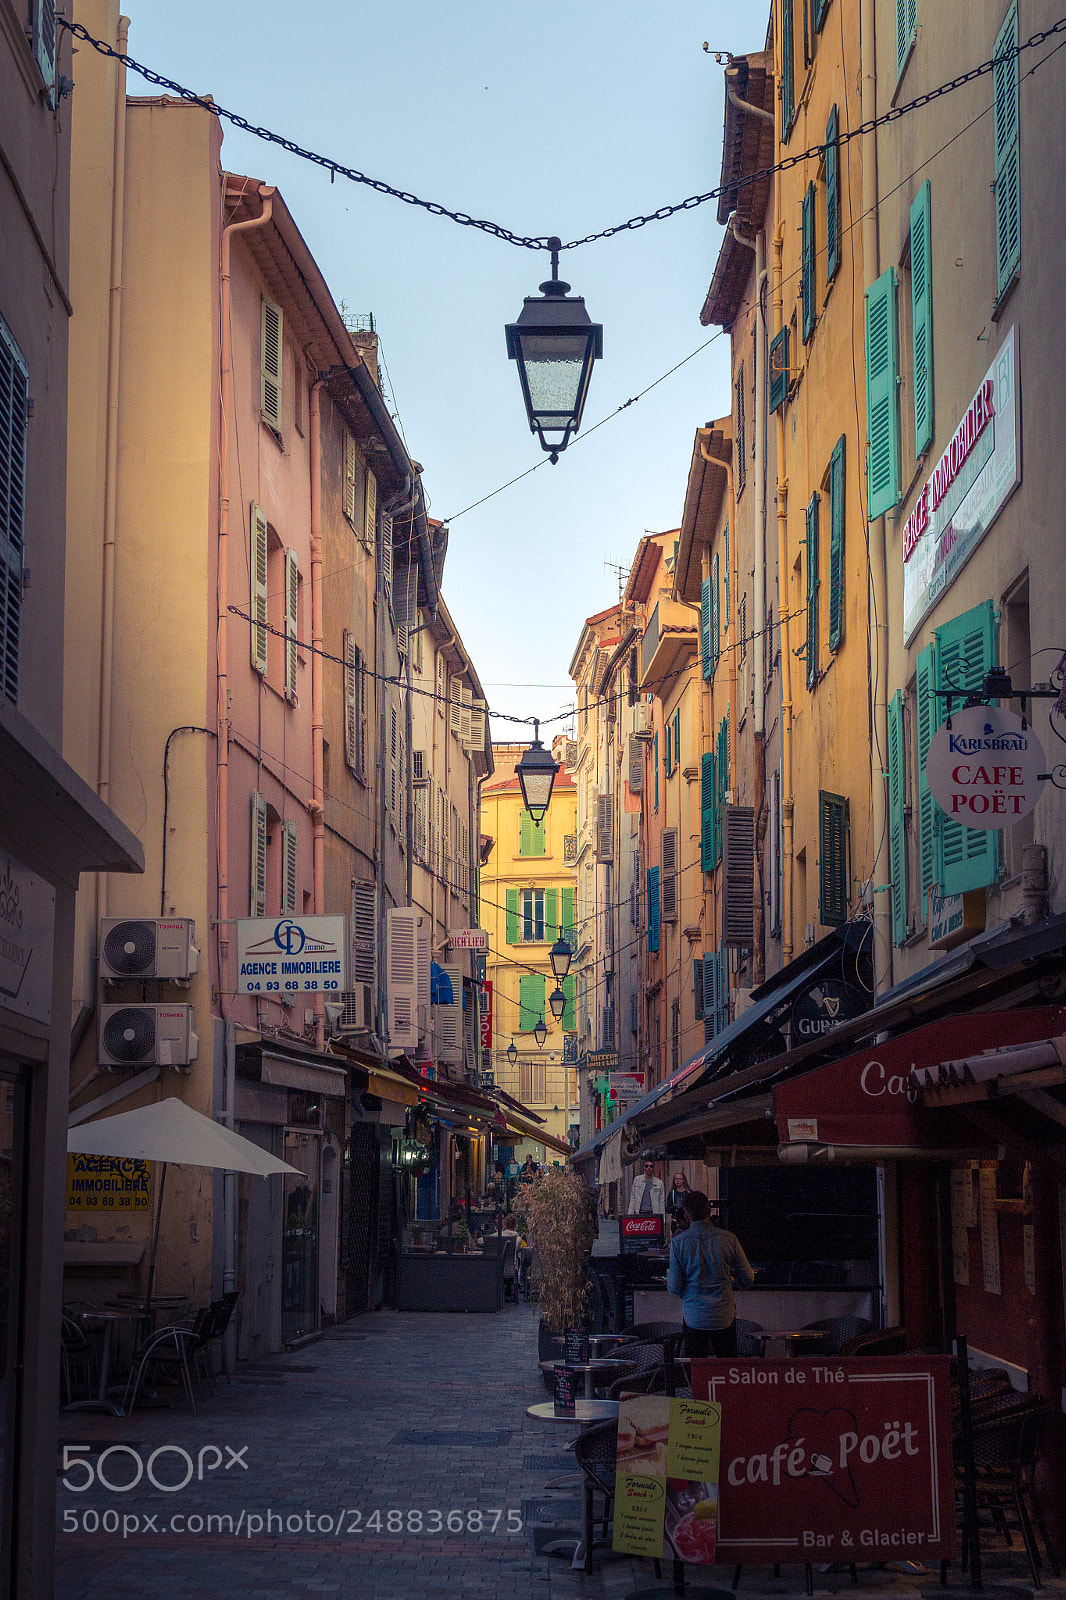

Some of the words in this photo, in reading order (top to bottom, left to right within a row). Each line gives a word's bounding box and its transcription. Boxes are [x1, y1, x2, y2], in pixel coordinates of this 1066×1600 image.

[932, 380, 995, 512] IMMOBILIER
[952, 766, 1024, 785] CAFE
[950, 790, 1026, 814] POËT
[305, 943, 325, 951] immo
[240, 962, 277, 975] AGENCE
[282, 961, 341, 975] IMMOBILIERE
[247, 982, 261, 991] 04
[266, 982, 279, 990] 93
[285, 981, 299, 990] 68
[304, 981, 317, 989] 38
[323, 981, 338, 989] 50
[75, 1160, 145, 1172] AGENCE
[72, 1179, 148, 1191] IMMOBILIERE
[70, 1197, 81, 1206] 04
[86, 1197, 97, 1206] 93
[102, 1197, 114, 1206] 68
[118, 1197, 130, 1206] 38
[135, 1197, 147, 1206] 50
[728, 1367, 779, 1384] Salon
[784, 1367, 806, 1383] de
[812, 1366, 845, 1383] Thé
[680, 1405, 711, 1416] Formule
[685, 1416, 706, 1425] Snack
[727, 1438, 807, 1486] café
[839, 1420, 919, 1468] Poët
[626, 1478, 656, 1490] Formule
[802, 1530, 834, 1547] Bar
[841, 1531, 854, 1546] &
[860, 1528, 925, 1546] Glacier
